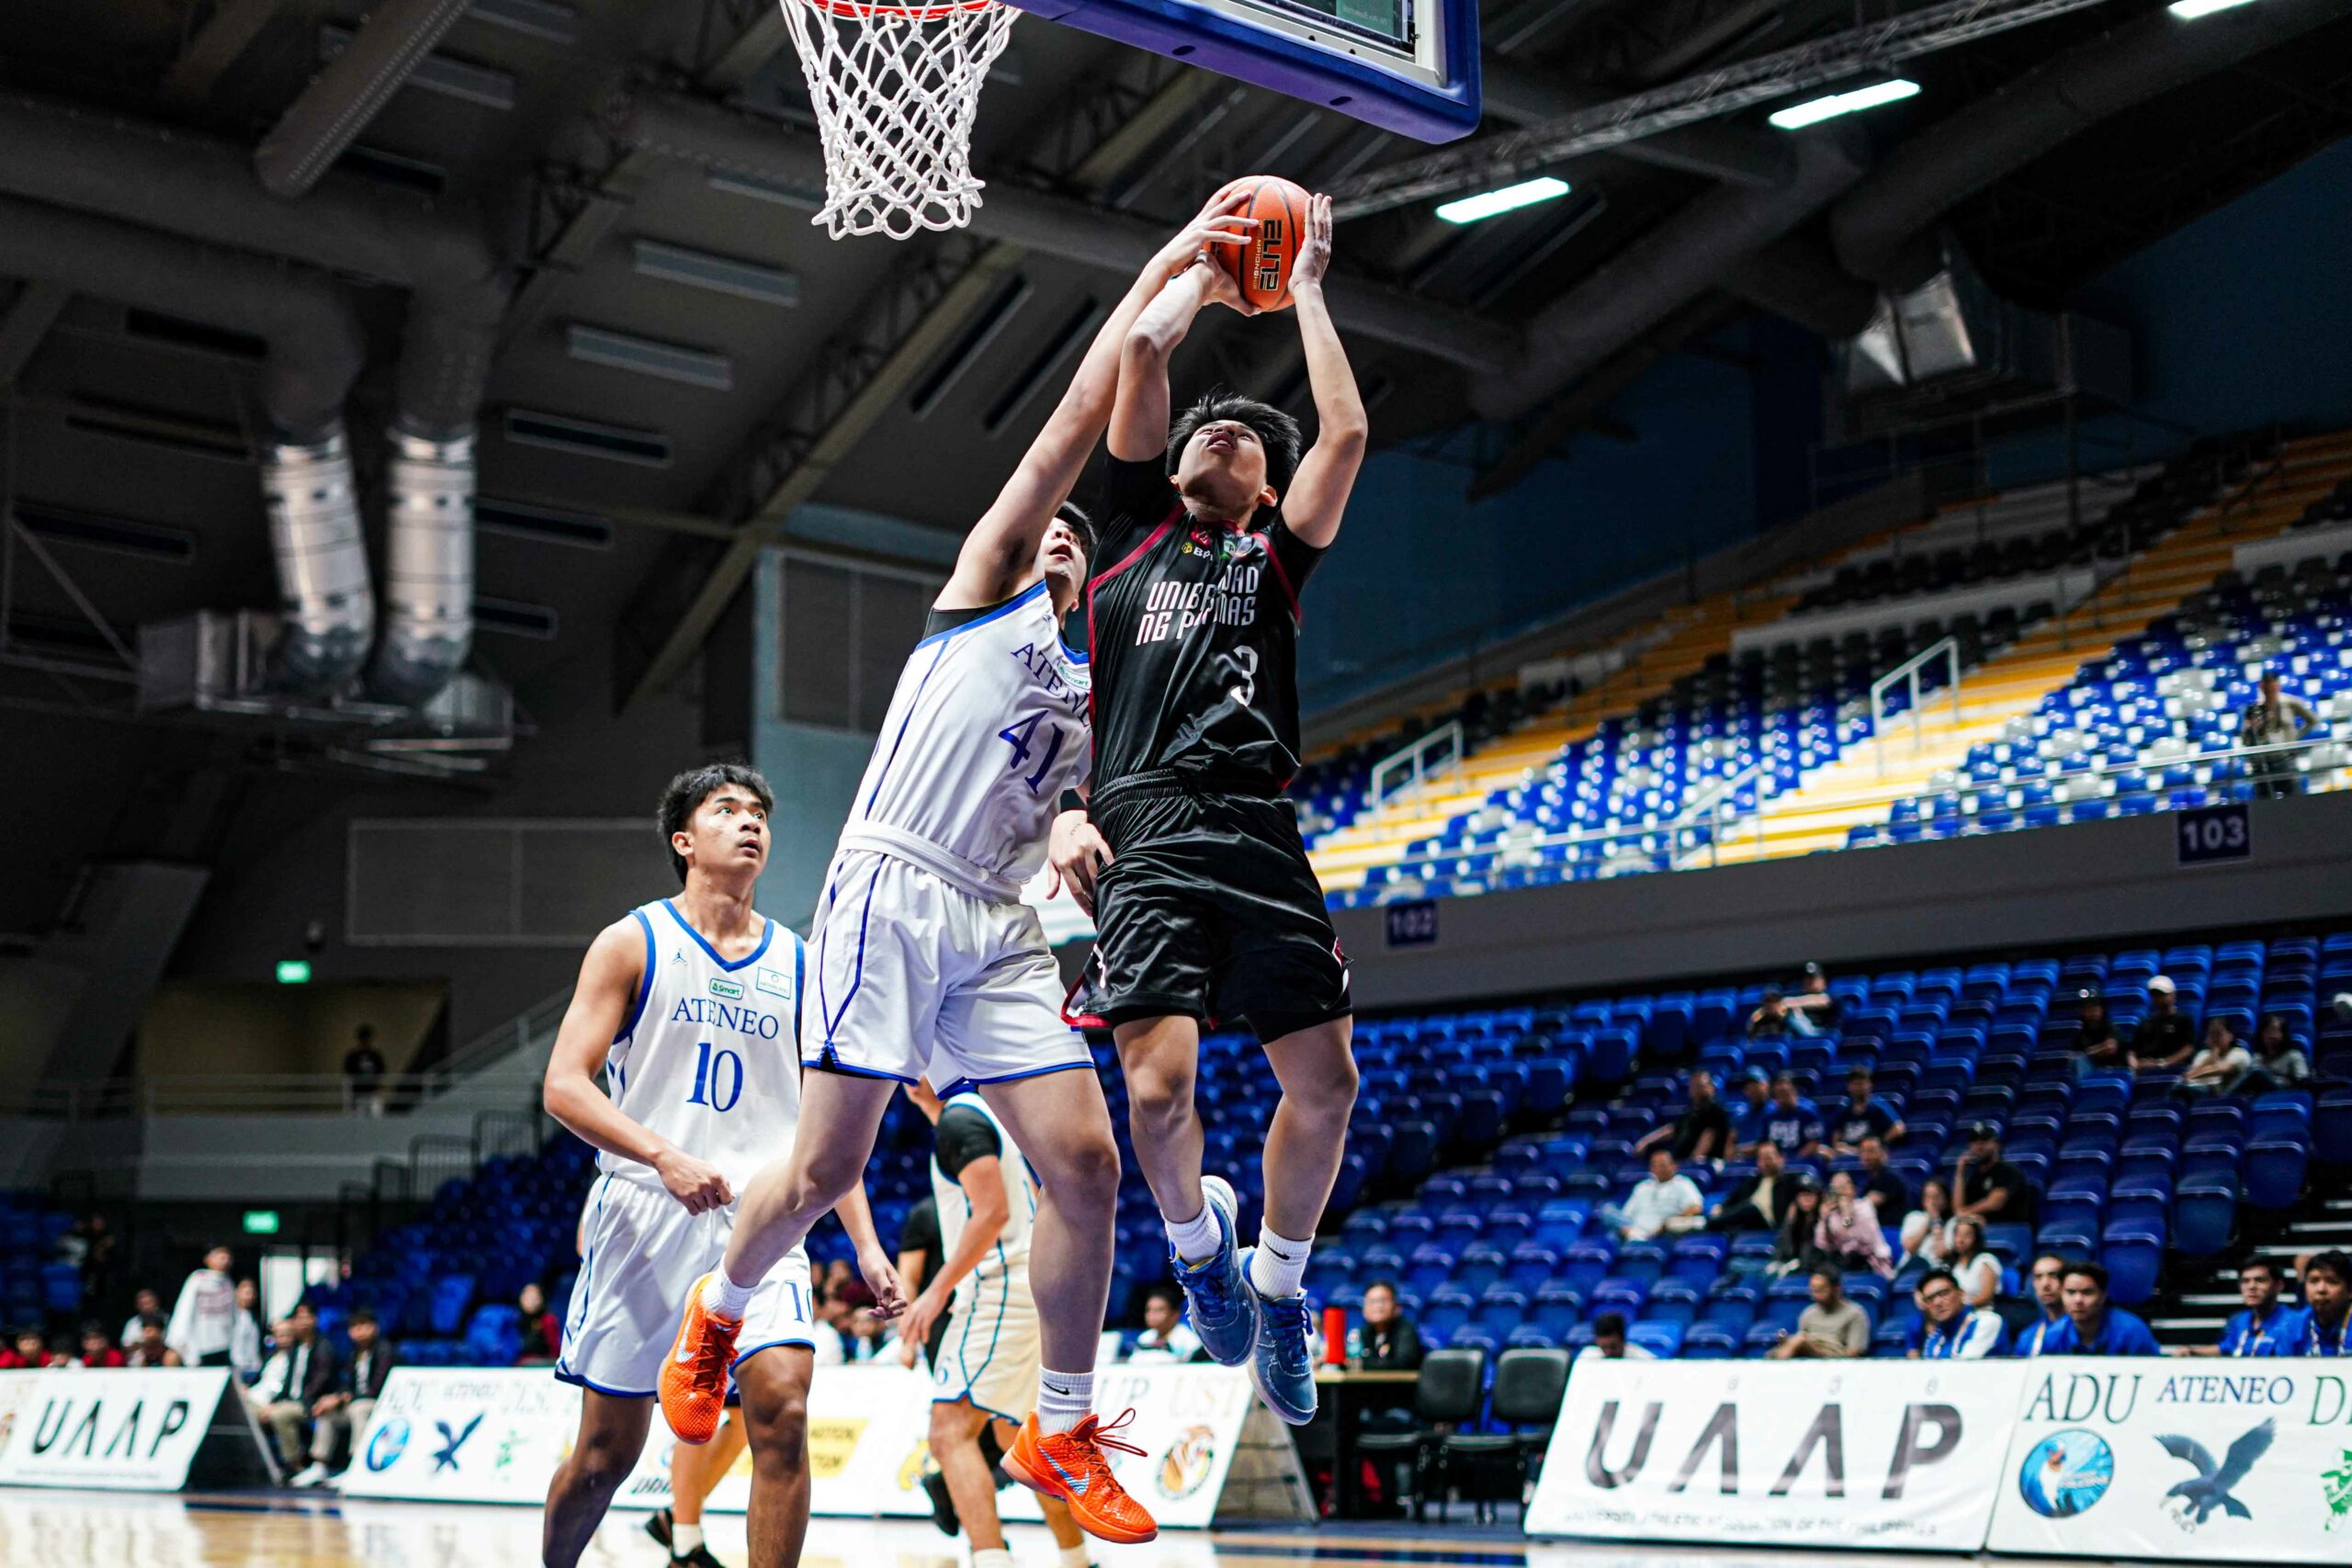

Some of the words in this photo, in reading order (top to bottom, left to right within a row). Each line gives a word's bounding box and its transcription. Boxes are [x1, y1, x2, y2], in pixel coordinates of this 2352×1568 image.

[1259, 219, 1283, 291] ELITE
[1193, 547, 1213, 561] BPI
[1135, 611, 1173, 647] NG
[1012, 642, 1091, 728] ATEN
[1233, 645, 1259, 707] 3
[998, 710, 1065, 795] 41
[2182, 815, 2245, 852] 103
[672, 997, 779, 1040] ATENEO
[718, 984, 741, 997] Smart
[686, 1043, 743, 1112] 10
[33, 1399, 189, 1458] UAAP
[2023, 1372, 2143, 1424] ADU
[2155, 1375, 2294, 1405] ATENEO
[2306, 1375, 2352, 1426] D
[1586, 1401, 1963, 1499] UAAP
